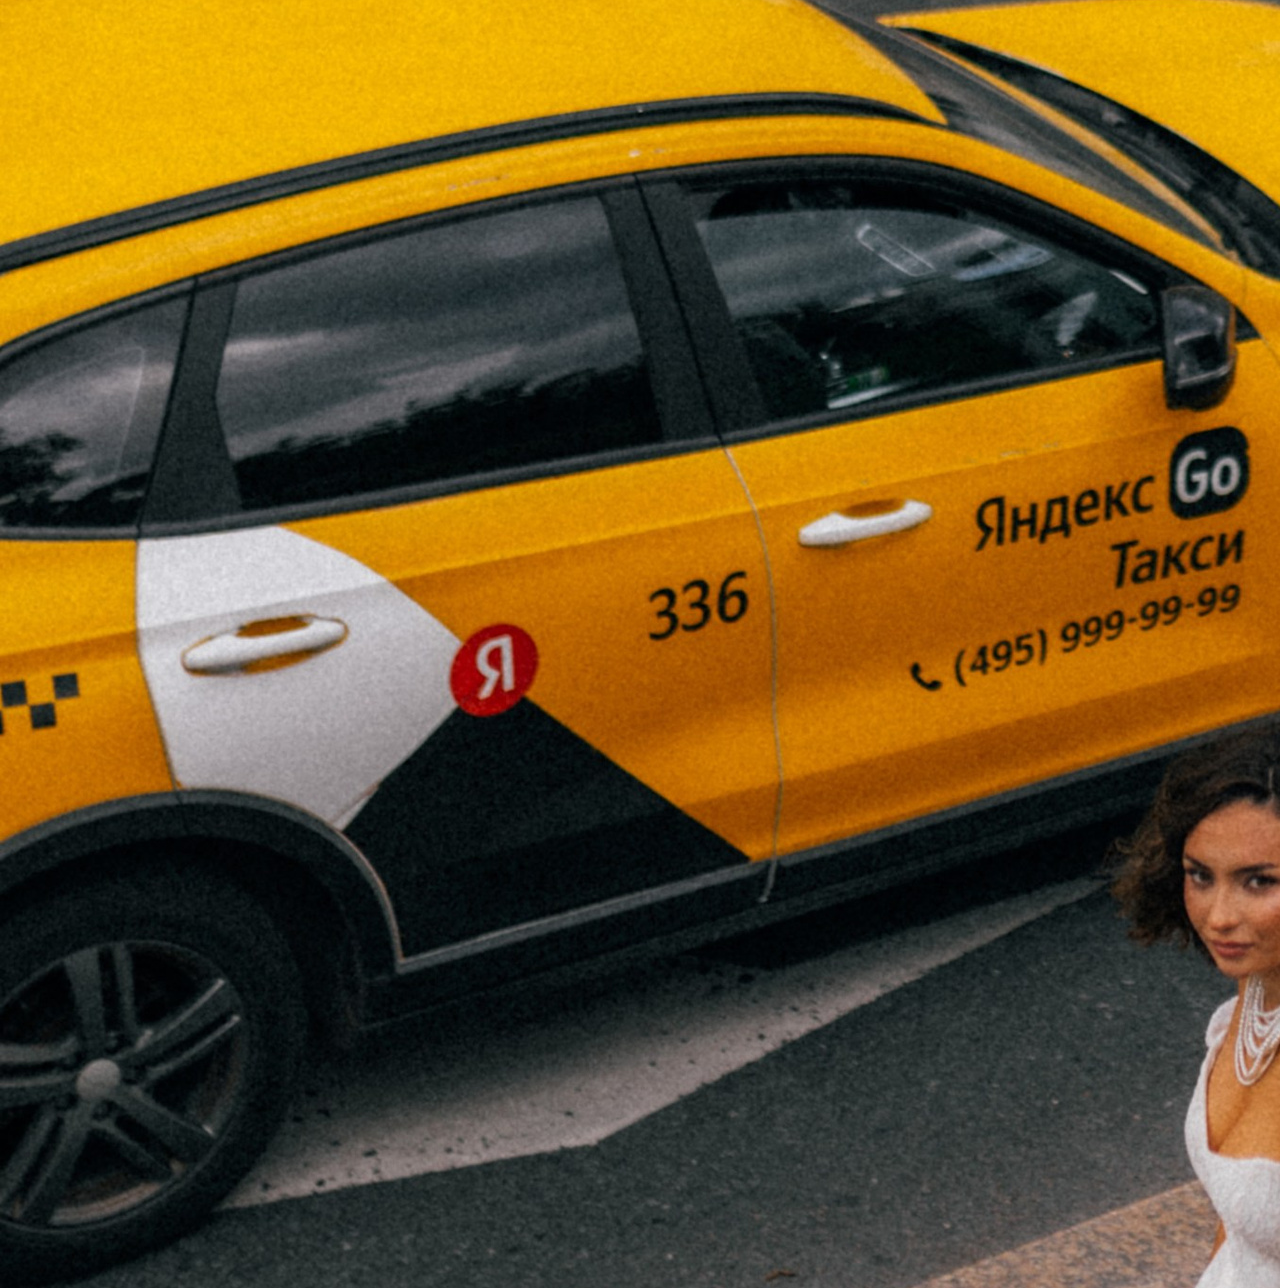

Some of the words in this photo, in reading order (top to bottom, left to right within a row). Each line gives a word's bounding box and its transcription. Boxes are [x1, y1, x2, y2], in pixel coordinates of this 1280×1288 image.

[975, 474, 1155, 552] Яндекс
[1175, 448, 1241, 504] Go
[1110, 529, 1246, 589] Такси
[648, 570, 749, 641] 336
[953, 628, 1048, 687] (495)
[1060, 583, 1242, 654] 999-99-99
[475, 634, 516, 701] Я
